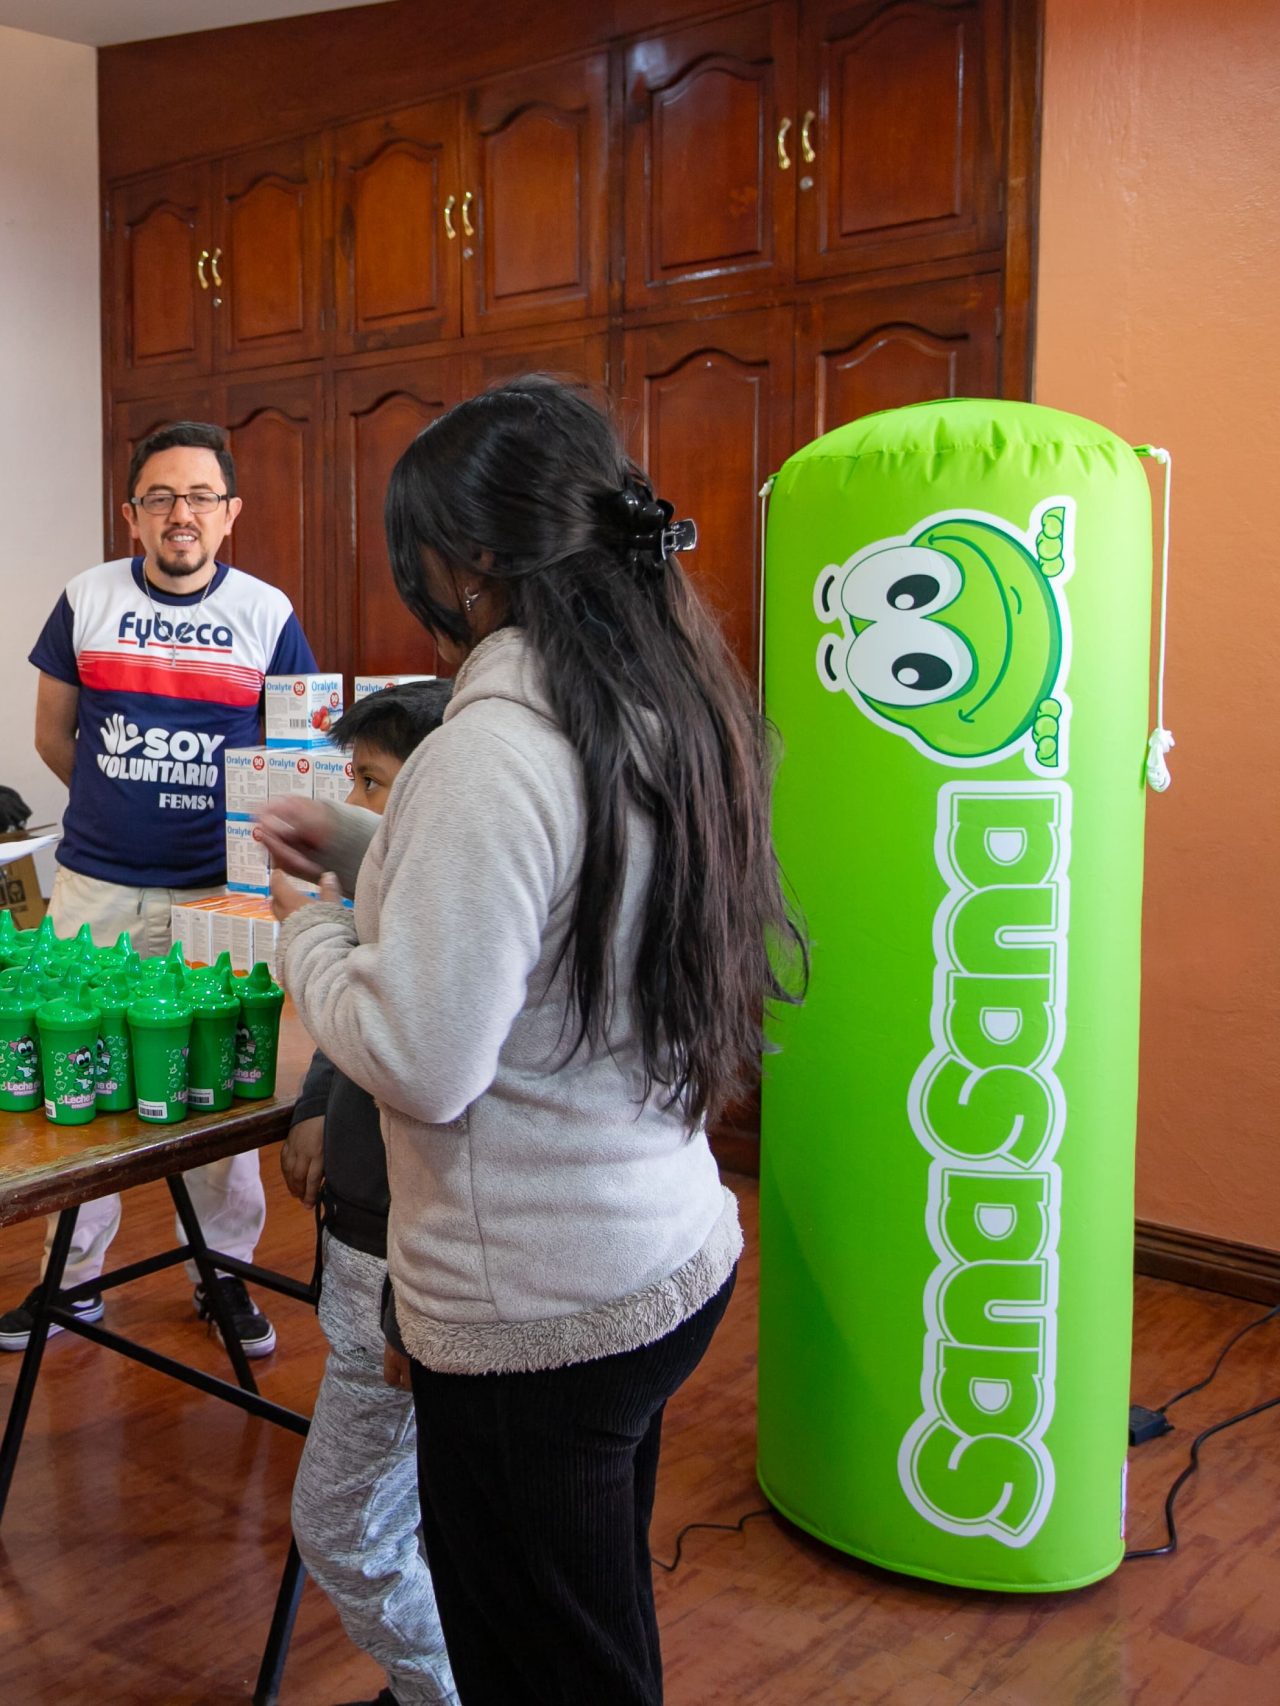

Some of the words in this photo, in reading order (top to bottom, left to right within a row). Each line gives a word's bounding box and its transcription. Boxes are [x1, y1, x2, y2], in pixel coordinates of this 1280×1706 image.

[266, 682, 291, 694] Oralyte
[311, 680, 338, 693] Oralyte
[143, 728, 225, 763] SOY
[226, 756, 251, 766] Oralyte
[269, 758, 295, 769] Oralyte
[315, 761, 343, 772] Oralyte
[97, 754, 219, 788] VOLUNTARIO
